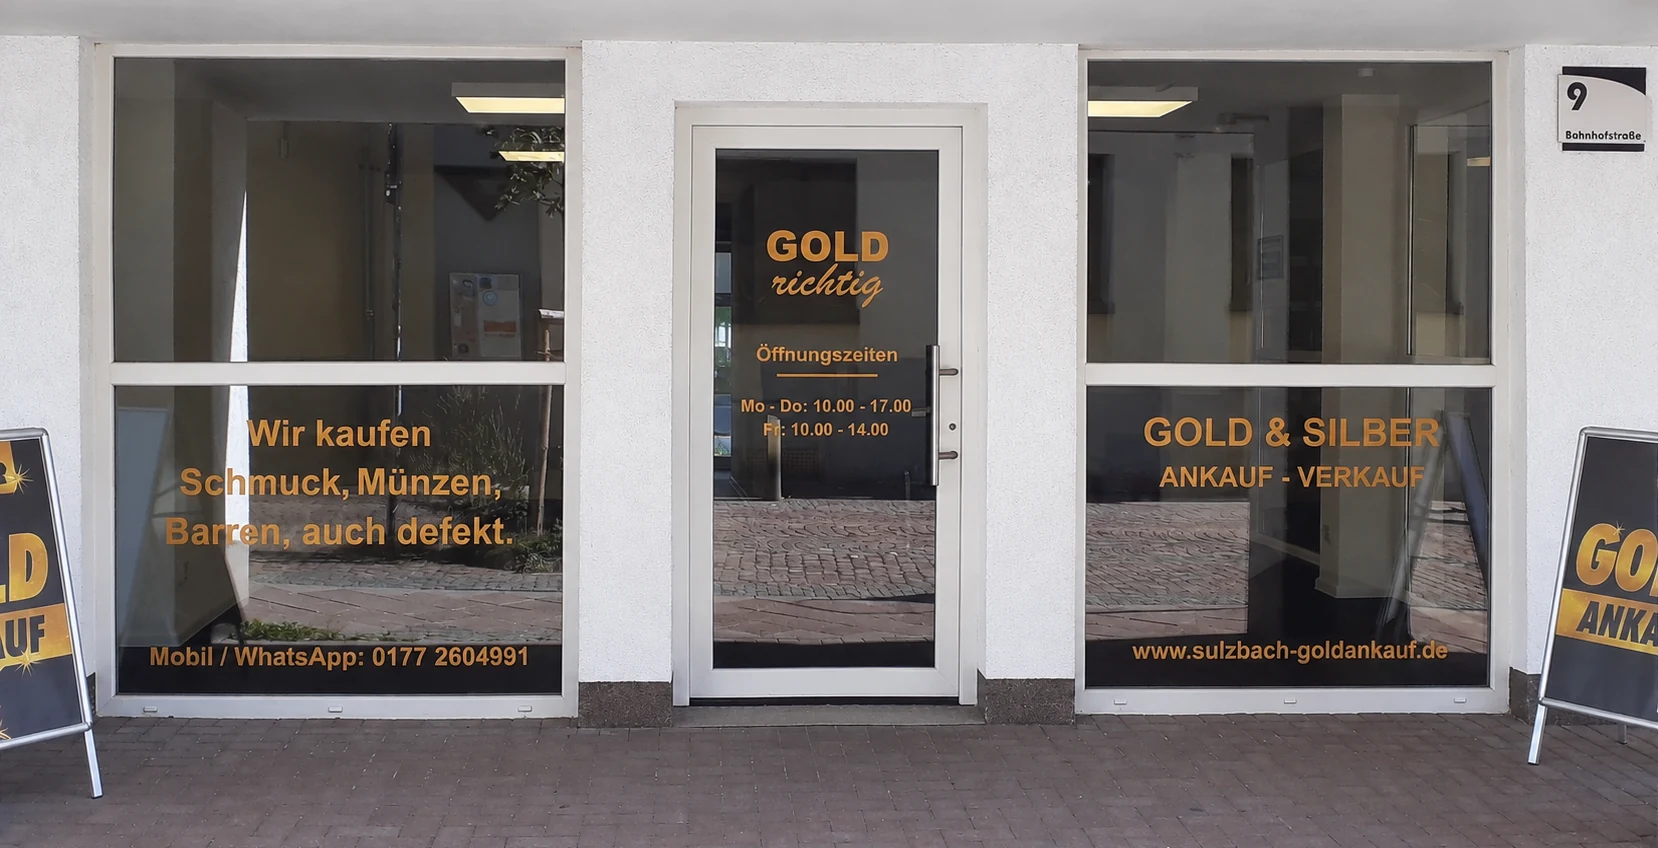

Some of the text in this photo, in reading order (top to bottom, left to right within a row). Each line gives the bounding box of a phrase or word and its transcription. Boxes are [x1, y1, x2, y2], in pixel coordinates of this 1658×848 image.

[1566, 81, 1588, 111] 9
[1565, 130, 1642, 141] Bahnhofstraße
[766, 229, 889, 263] GOLD
[771, 263, 884, 308] richtig
[756, 343, 898, 366] Öffnungszeiten
[740, 399, 766, 413] Mo
[780, 399, 808, 413] Do:
[814, 399, 855, 413] 10.00
[870, 399, 912, 413] 17.00
[248, 419, 431, 447] Wir kaufen
[763, 422, 785, 437] Fr:
[791, 422, 833, 436] 10.00
[848, 422, 889, 436] 14.00
[1144, 417, 1439, 447] GOLD & SILBER
[180, 468, 502, 501] Schmuck, Münzen,
[1159, 466, 1273, 488] ANKAUF
[1298, 466, 1424, 488] VERKAUF
[166, 517, 514, 550] Barren, auch defekt.
[150, 647, 528, 671] Mobil / WhatsApp: 0177 2604991
[1132, 641, 1449, 664] www.sulzbach-goldankauf.de
